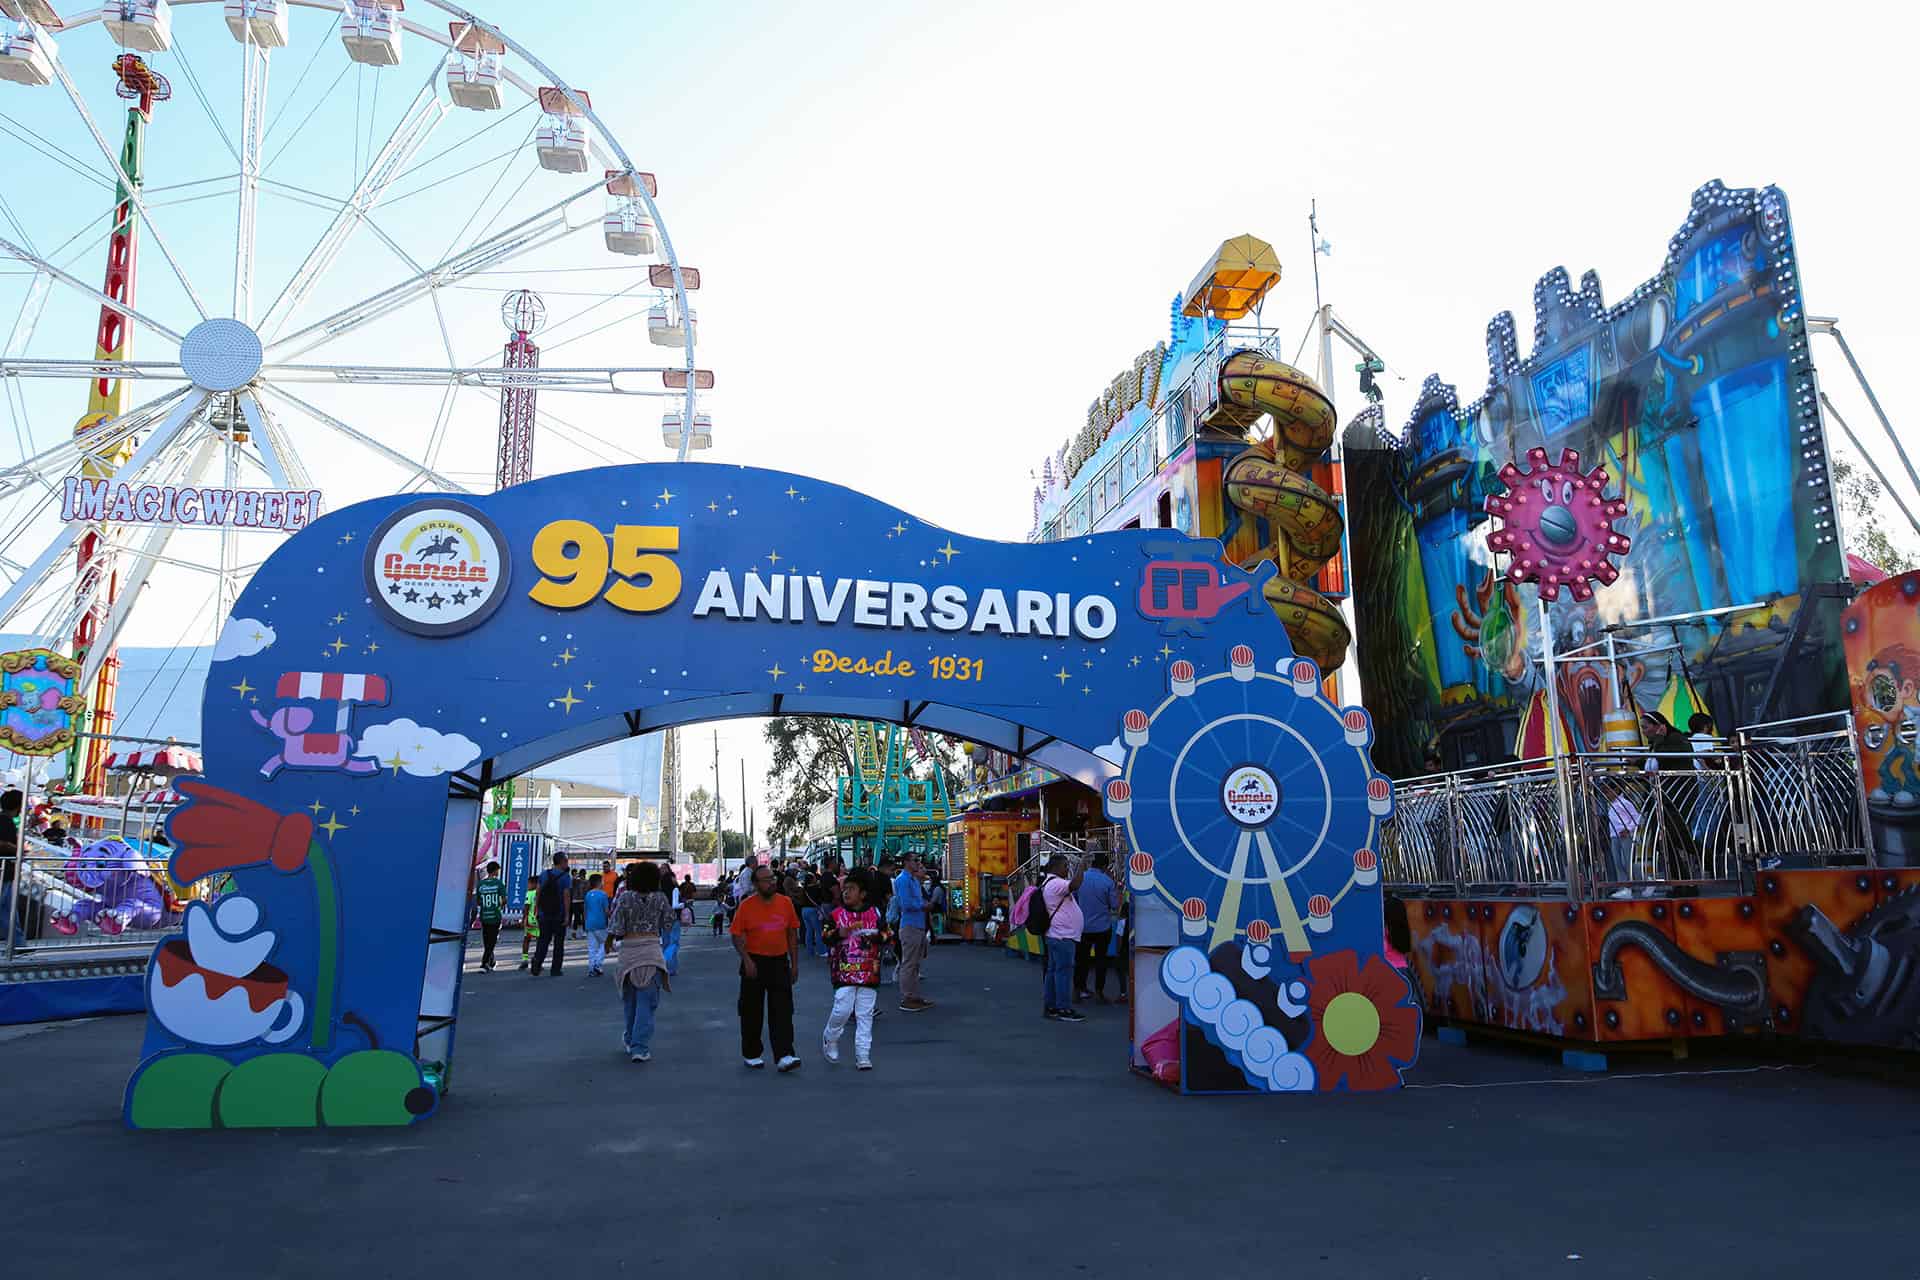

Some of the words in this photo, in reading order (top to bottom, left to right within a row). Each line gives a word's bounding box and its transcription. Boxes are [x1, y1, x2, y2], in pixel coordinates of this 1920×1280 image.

[420, 522, 463, 534] GRUPO
[528, 519, 682, 612] 95
[692, 570, 1118, 640] ANIVERSARIO
[812, 649, 916, 677] Desde
[928, 655, 984, 682] 1931
[513, 847, 523, 904] TAQUILLA
